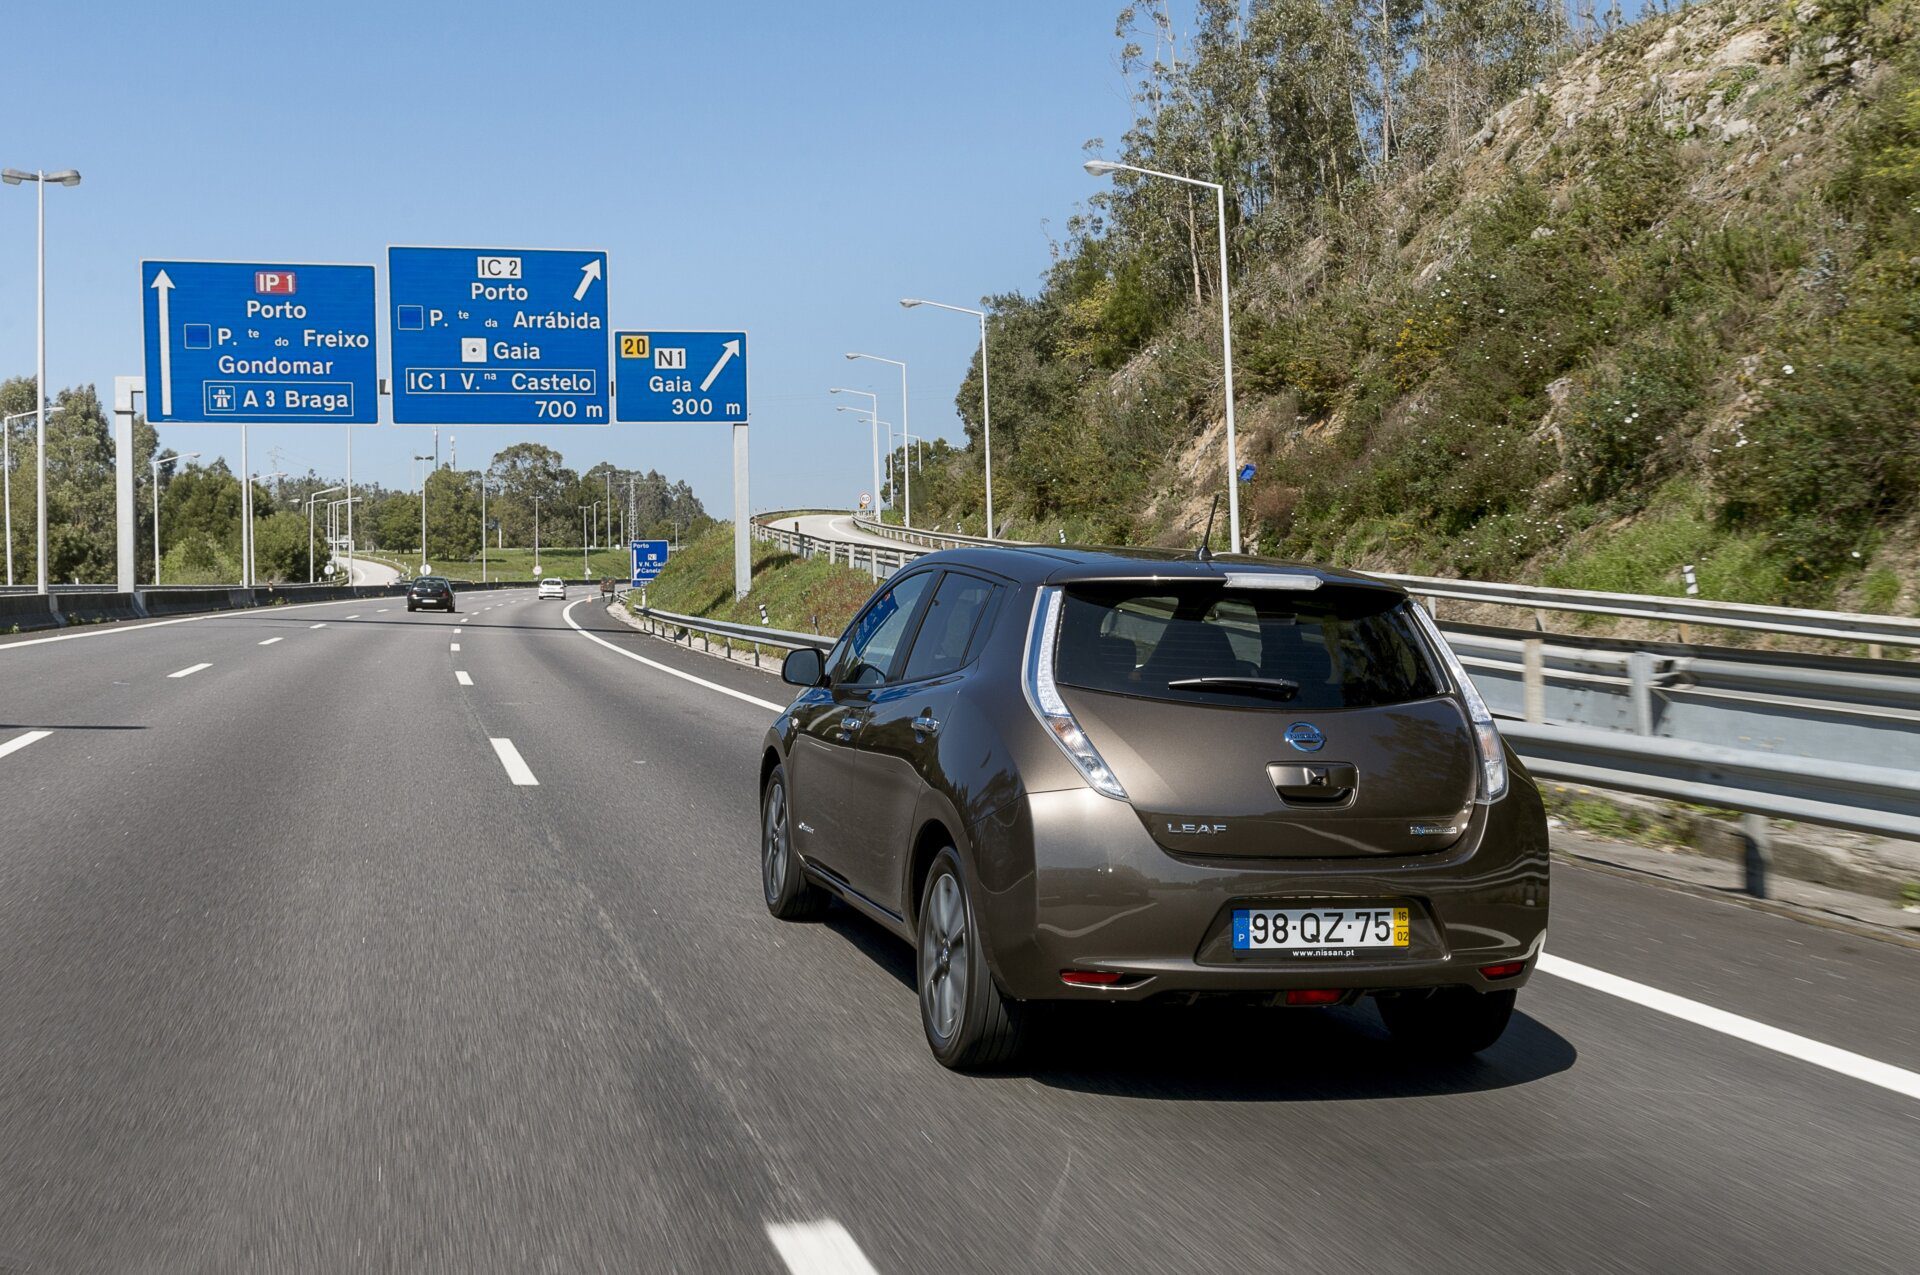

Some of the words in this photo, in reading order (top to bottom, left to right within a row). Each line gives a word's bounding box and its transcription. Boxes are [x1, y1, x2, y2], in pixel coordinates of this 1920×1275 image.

[481, 259, 502, 276] IC
[509, 260, 518, 277] 2
[259, 274, 279, 291] IP
[286, 275, 293, 292] 1
[471, 282, 528, 301] Porto
[247, 300, 307, 319] Porto
[429, 309, 448, 327] P.
[458, 310, 469, 319] te
[485, 318, 498, 328] da
[513, 311, 601, 329] Arrábida
[218, 328, 237, 346] P.
[248, 329, 259, 339] te
[275, 337, 289, 347] do
[303, 329, 369, 348] Freixo
[624, 338, 646, 355] 20
[493, 342, 540, 360] Gaia
[658, 351, 682, 366] N1
[218, 355, 333, 375] Gondomar
[410, 372, 433, 390] IC
[440, 373, 446, 390] 1
[511, 372, 591, 391] Castelo
[649, 376, 692, 392] Gaia
[243, 390, 259, 408] A
[265, 391, 275, 408] 3
[285, 390, 348, 412] Braga
[535, 401, 577, 418] 700
[586, 405, 603, 417] m
[672, 399, 712, 415] 300
[726, 402, 740, 415] m
[1167, 823, 1228, 835] LEAF
[1398, 911, 1408, 922] 16
[1238, 934, 1245, 942] P
[1397, 931, 1409, 942] 02
[1292, 950, 1355, 958] www.nissan.pt
